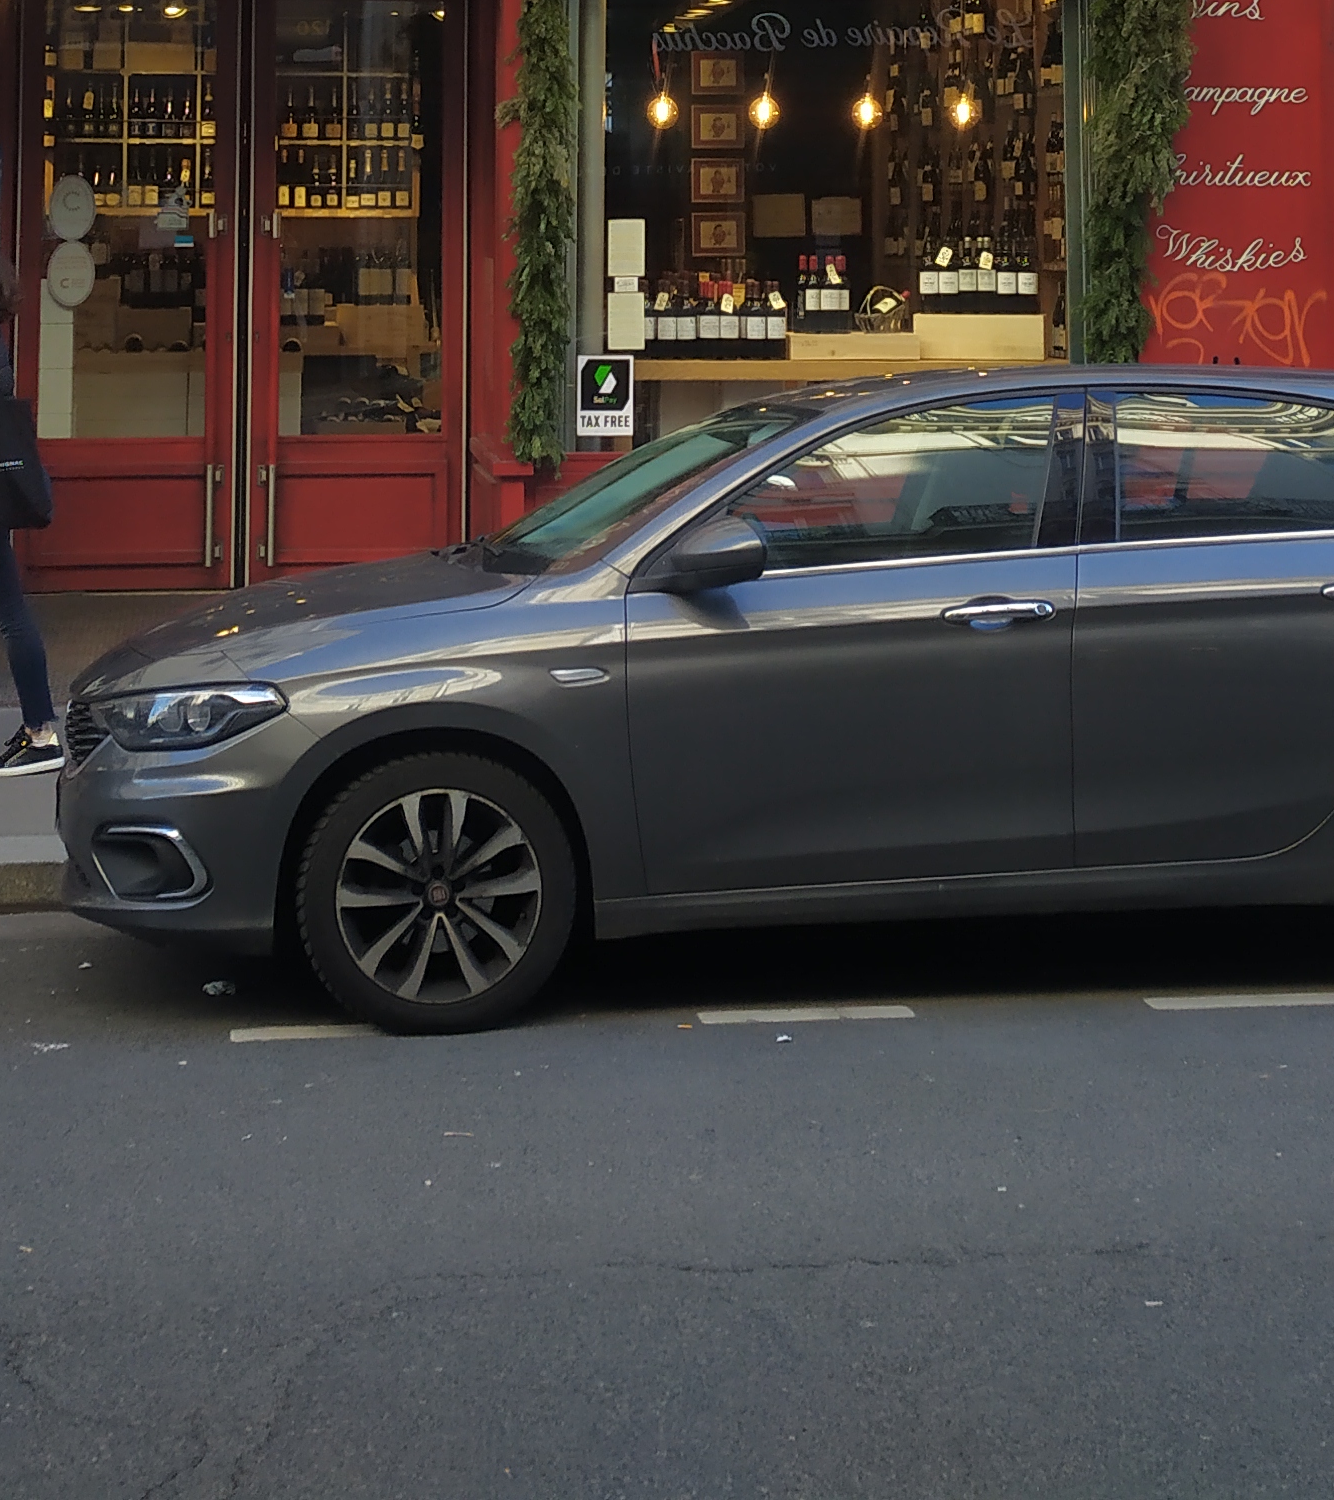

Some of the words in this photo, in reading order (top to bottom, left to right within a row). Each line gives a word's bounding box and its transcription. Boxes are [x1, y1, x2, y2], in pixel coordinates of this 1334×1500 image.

[1181, 70, 1309, 116] ampagne
[1155, 225, 1308, 272] Whiskies
[580, 415, 601, 428] TAX
[604, 415, 630, 428] FREE
